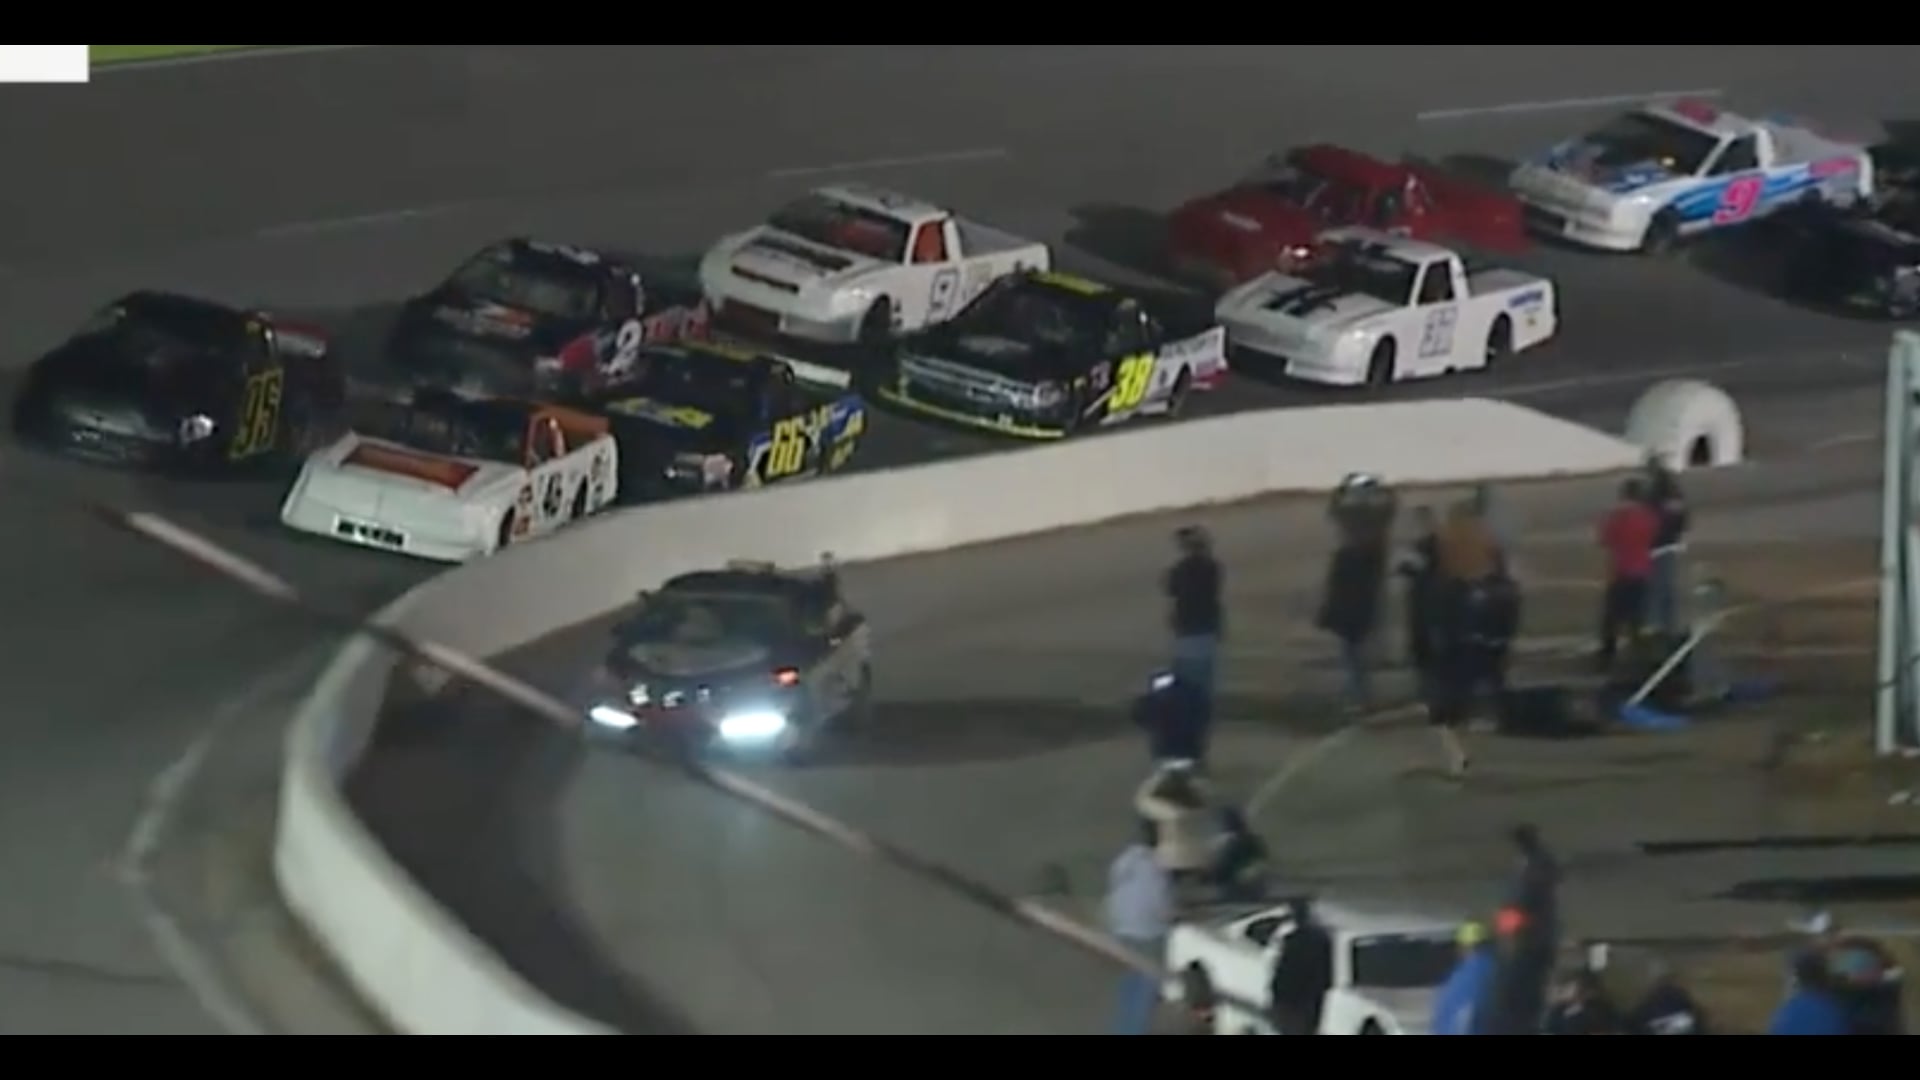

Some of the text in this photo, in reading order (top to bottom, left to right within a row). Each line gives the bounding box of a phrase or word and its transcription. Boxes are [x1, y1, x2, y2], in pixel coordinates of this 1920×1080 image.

[1713, 173, 1766, 225] 9
[1108, 352, 1155, 412] 38
[766, 416, 806, 477] 66
